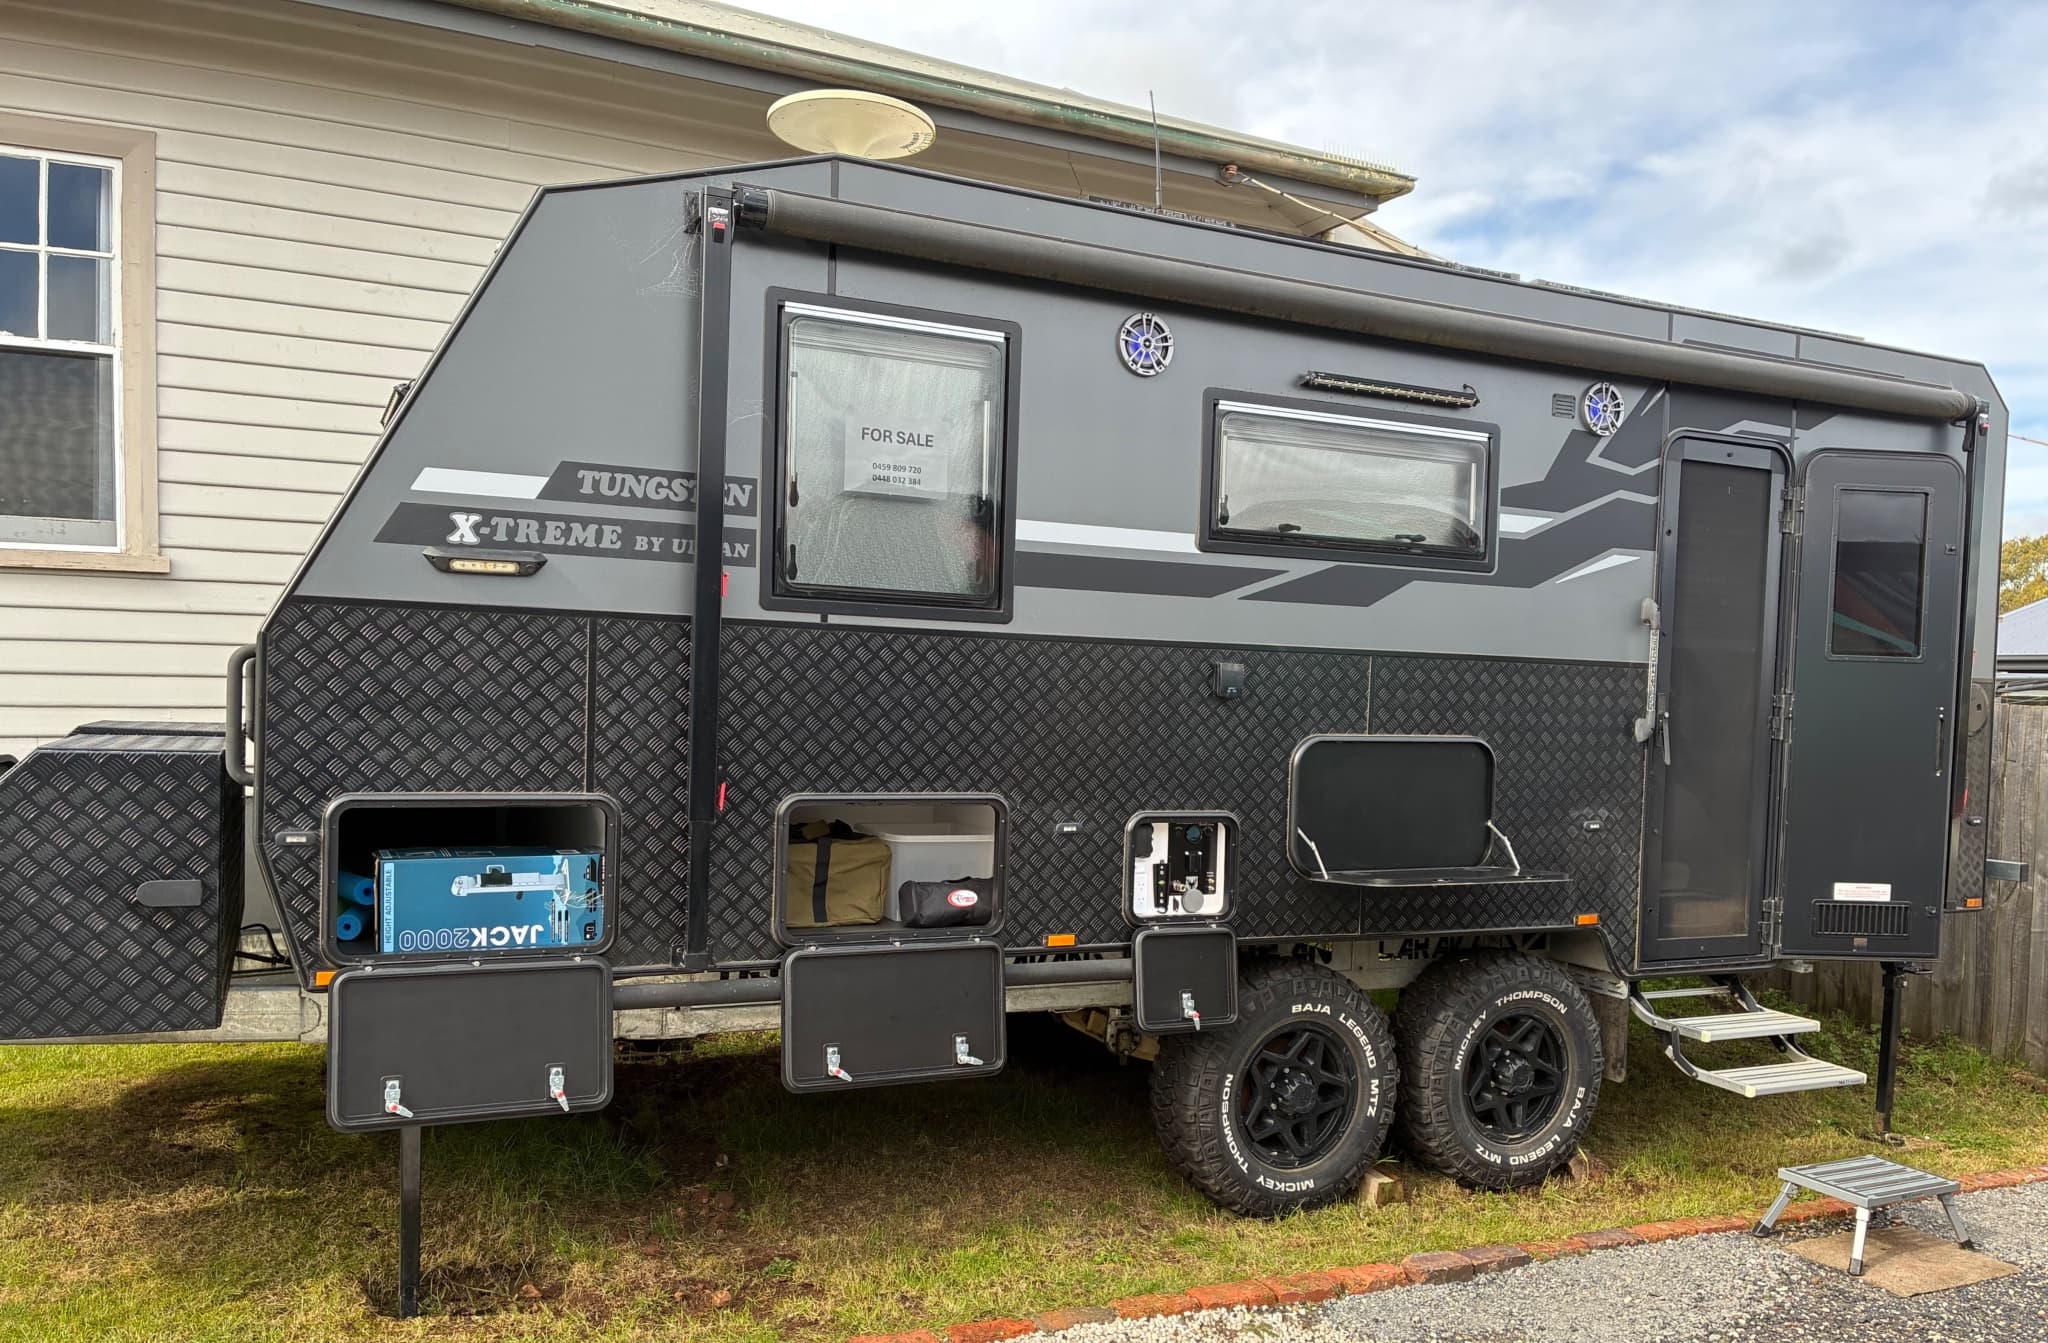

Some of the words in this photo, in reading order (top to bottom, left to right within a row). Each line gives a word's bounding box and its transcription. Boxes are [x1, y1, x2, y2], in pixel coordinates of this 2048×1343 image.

[861, 426, 893, 443] FOR
[896, 431, 935, 448] SALE
[872, 462, 891, 472] 0459
[892, 465, 907, 473] 809
[908, 466, 922, 474] 720
[872, 474, 891, 483] 0448
[892, 476, 906, 484] 032
[908, 477, 921, 486] 384
[577, 469, 753, 507] TUNGSN
[447, 511, 622, 550] X-TREME
[634, 535, 665, 553] BY
[671, 538, 750, 558] UAN
[385, 869, 393, 916] ADJUSTABLE
[385, 917, 393, 944] HEIGHT
[399, 924, 544, 952] JACK2000
[1454, 1010, 1488, 1070] MICKEY
[1495, 990, 1568, 1015] THOMPSON
[1291, 1003, 1331, 1016] BAJA
[1338, 1012, 1377, 1069] LEGEND
[1366, 1079, 1380, 1117] MTZ
[1562, 1086, 1586, 1128] BAJA
[1221, 1073, 1250, 1174] THOMPSON
[1475, 1143, 1502, 1165] MTZ
[1509, 1134, 1561, 1165] LEGEND
[1255, 1174, 1315, 1193] MICKEY
